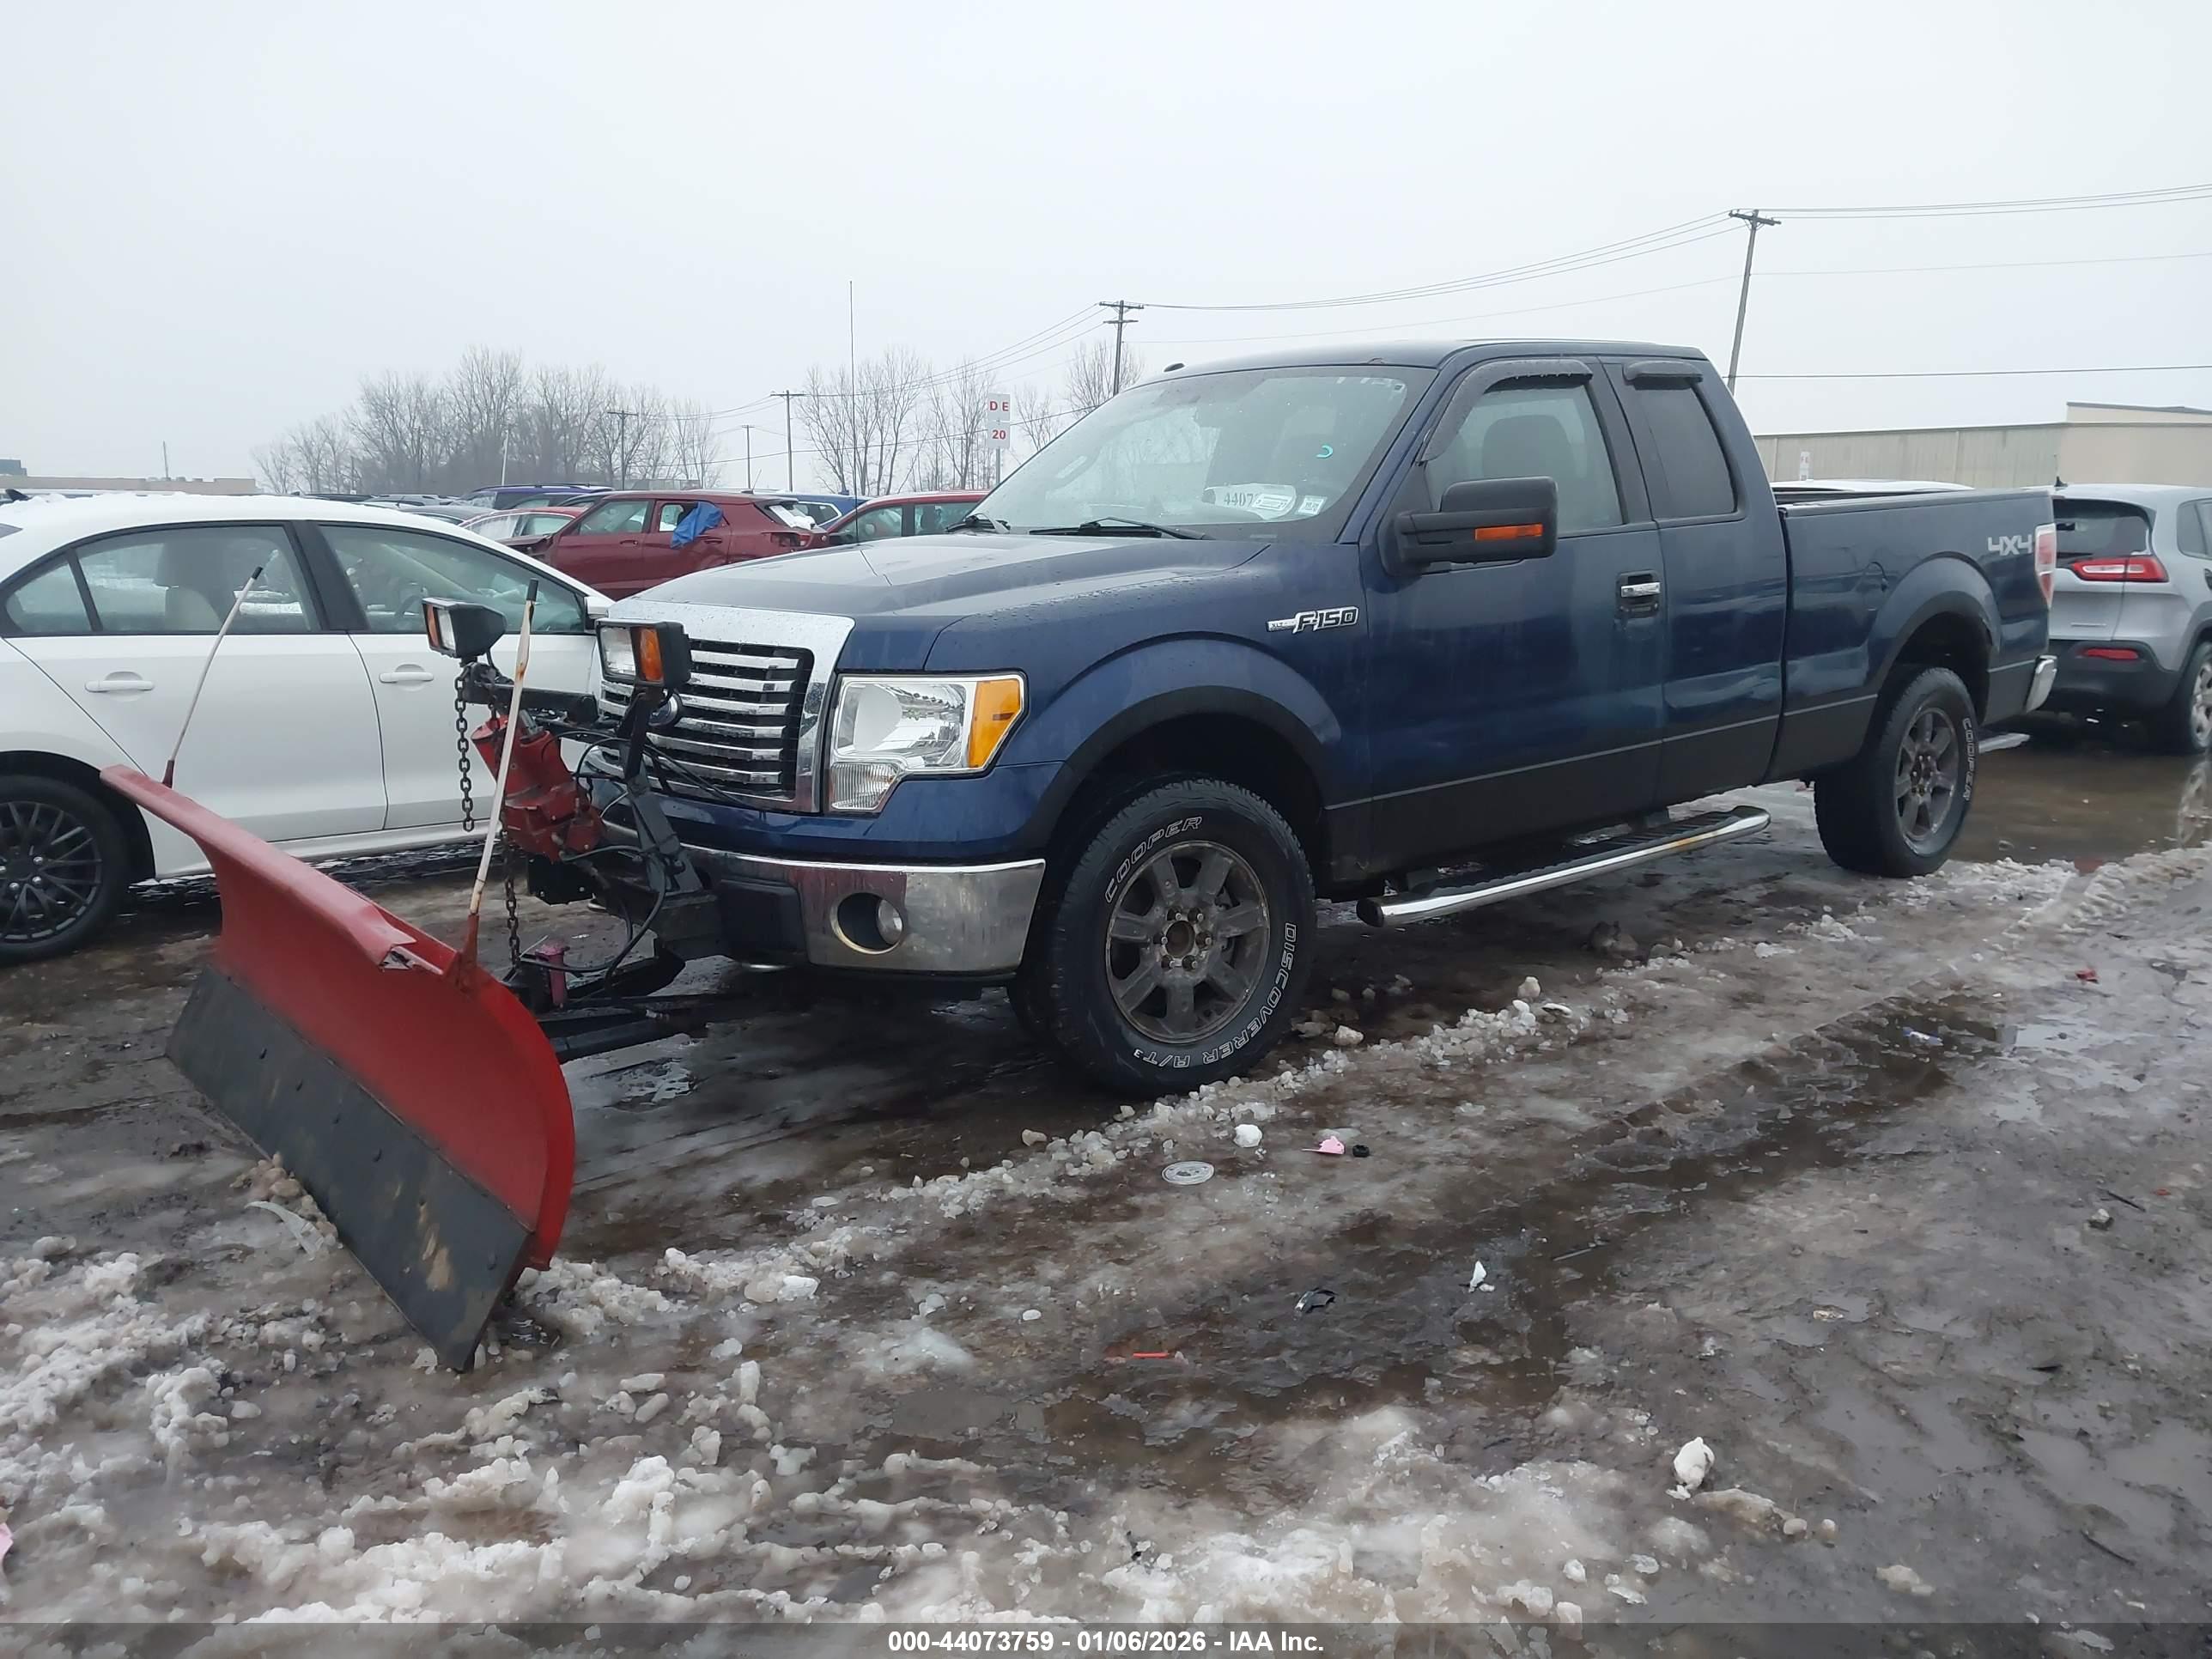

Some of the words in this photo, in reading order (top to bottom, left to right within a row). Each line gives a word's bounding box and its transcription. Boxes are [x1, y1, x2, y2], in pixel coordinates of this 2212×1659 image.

[993, 429, 1006, 440] 20
[1293, 606, 1358, 634] F-150
[1104, 816, 1203, 904] COOPER
[1203, 922, 1297, 1065] DISCOVERER
